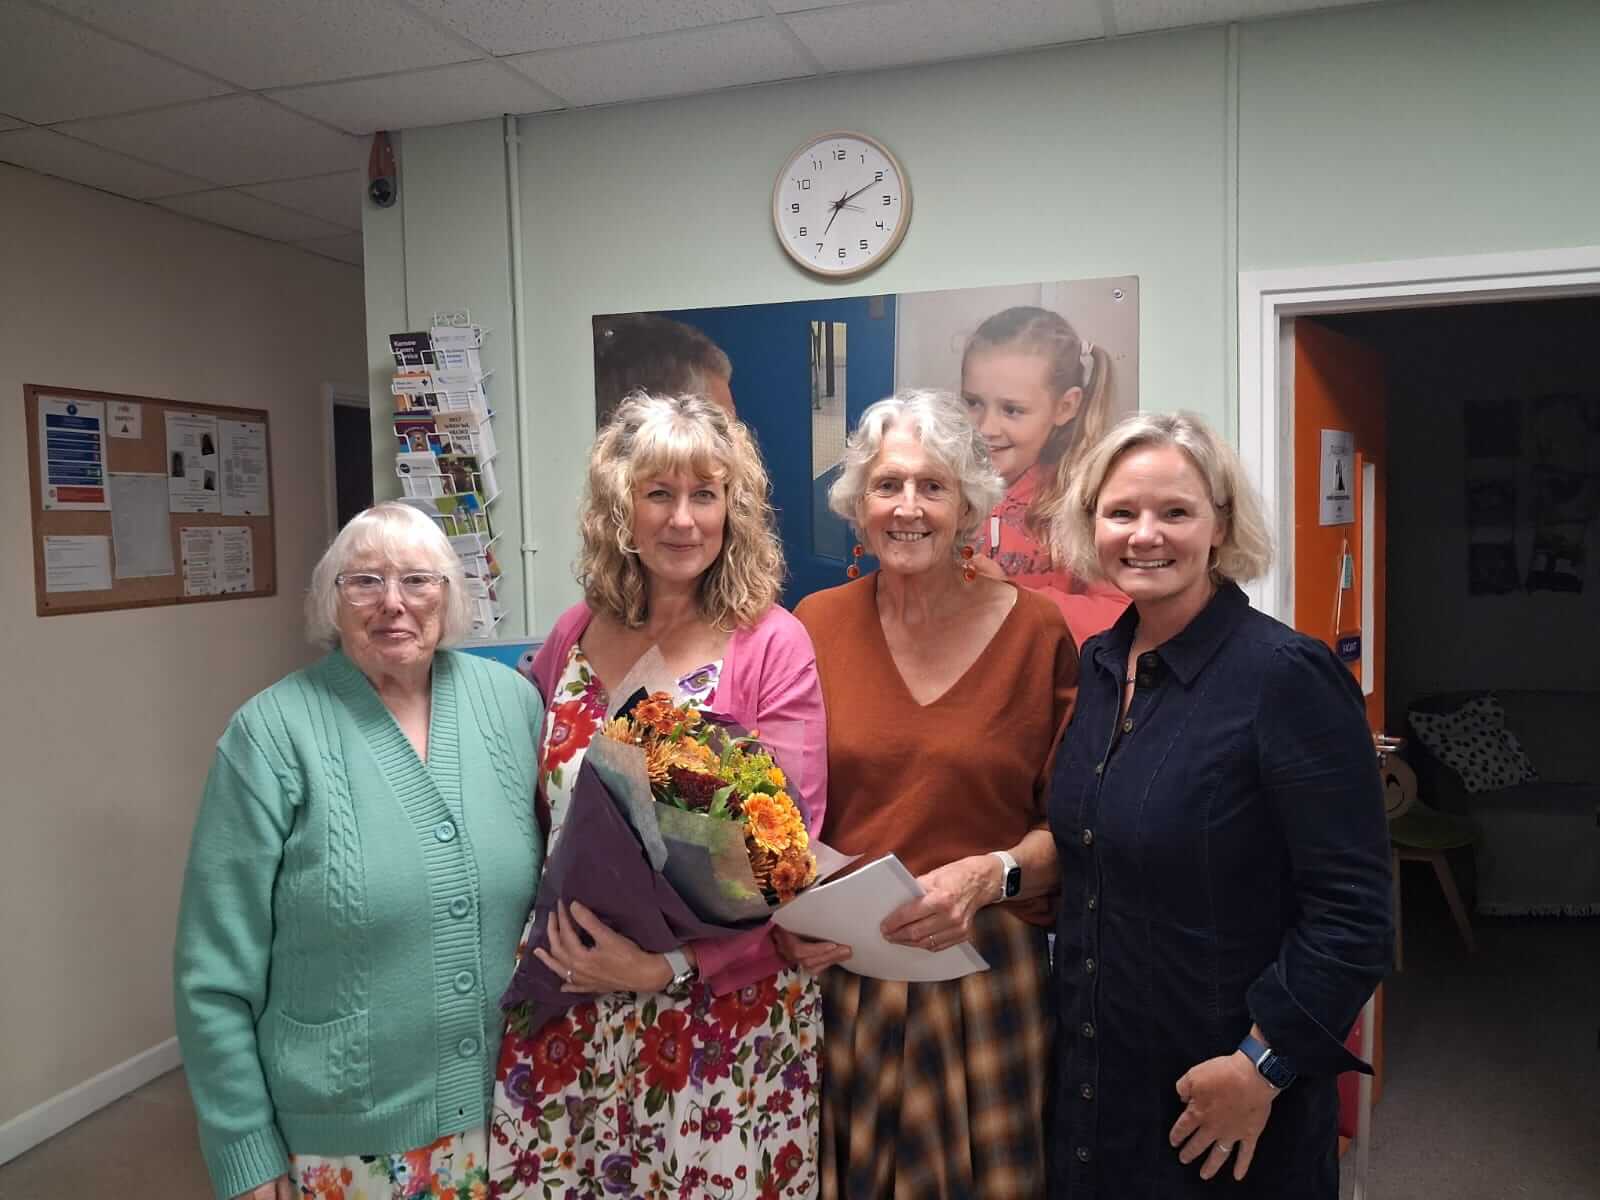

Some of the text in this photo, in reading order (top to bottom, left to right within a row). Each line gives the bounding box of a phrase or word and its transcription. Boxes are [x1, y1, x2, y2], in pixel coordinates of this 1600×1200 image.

[832, 150, 846, 160] 12
[812, 160, 823, 170] 11
[874, 171, 883, 182] 2
[796, 179, 811, 190] 10
[882, 195, 891, 206] 3
[791, 203, 800, 213] 9
[875, 220, 884, 231] 4
[799, 226, 808, 237] 8
[815, 242, 824, 253] 7
[859, 239, 868, 250] 5
[838, 248, 847, 258] 6
